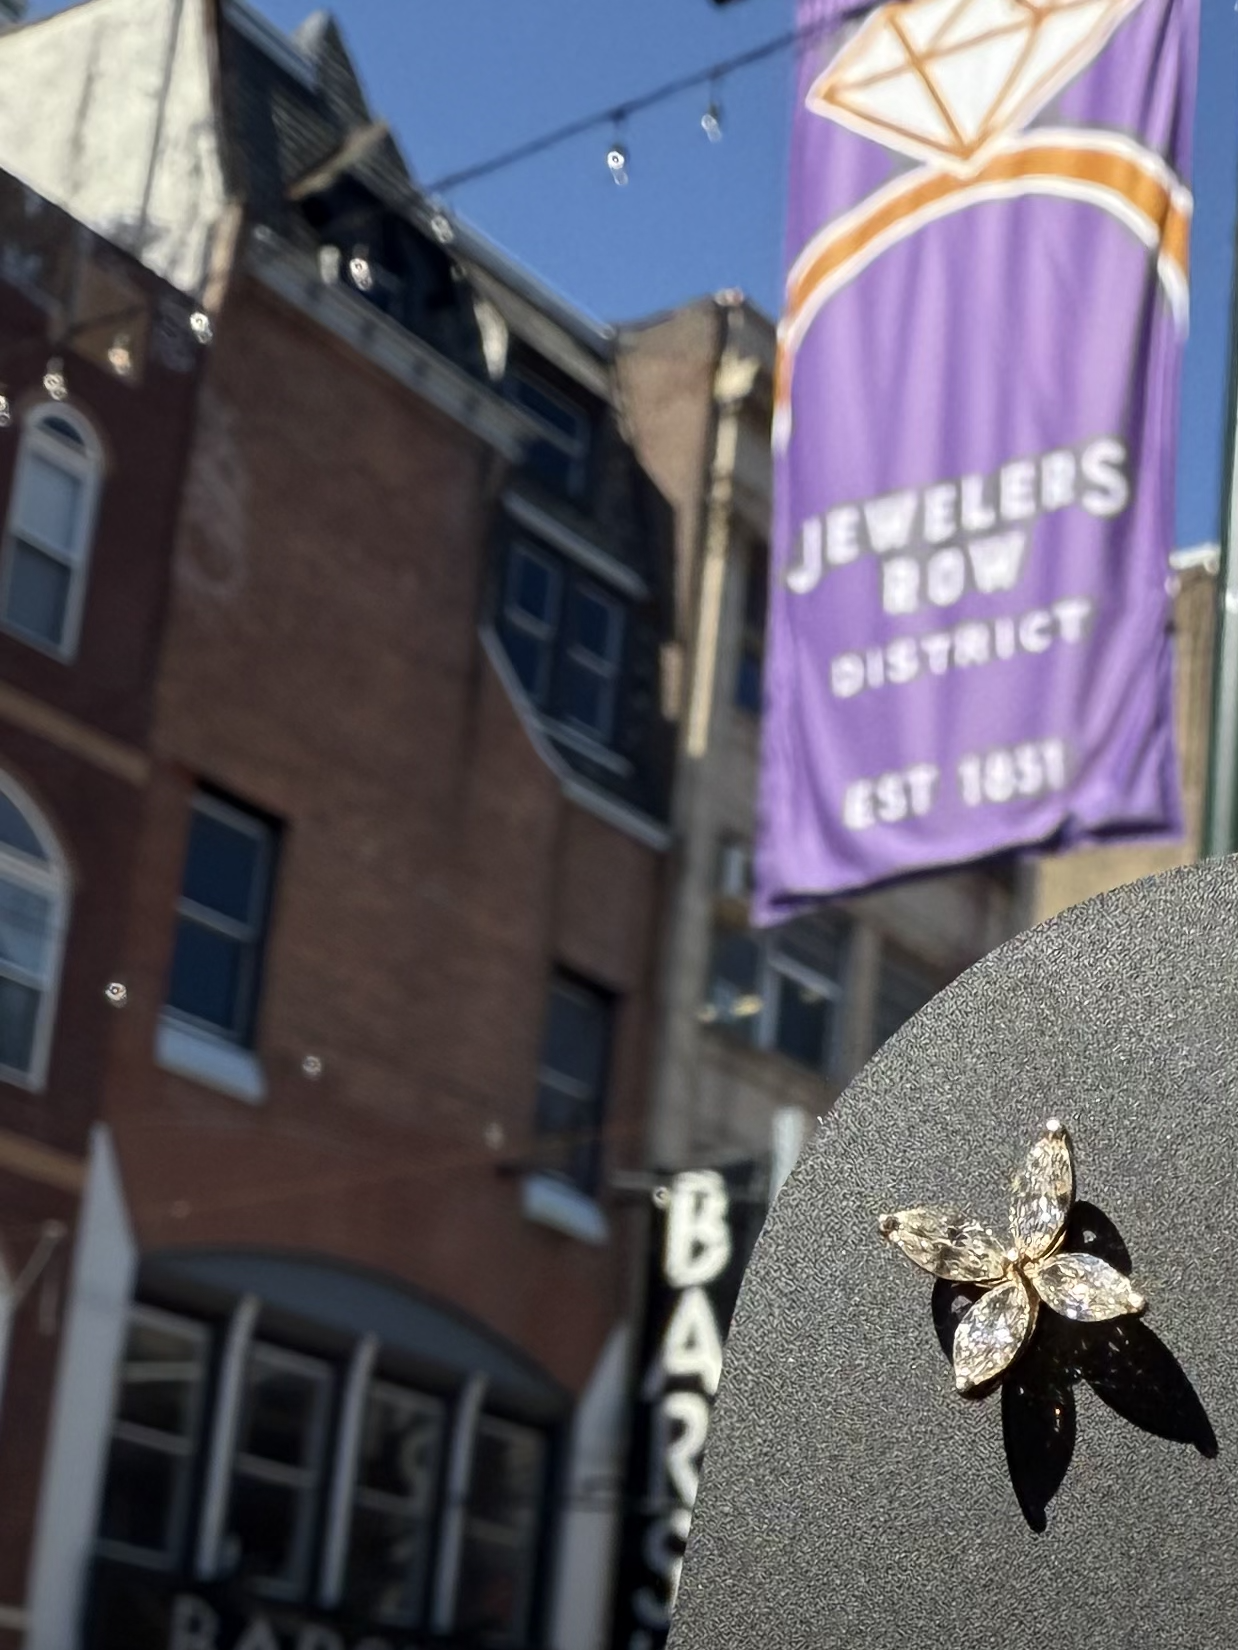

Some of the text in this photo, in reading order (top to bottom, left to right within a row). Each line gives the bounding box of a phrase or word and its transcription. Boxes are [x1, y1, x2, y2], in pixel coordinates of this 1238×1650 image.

[786, 438, 1129, 594] JEWELERS
[882, 530, 1026, 615] ROW
[831, 599, 1091, 698] DISTRICT
[842, 762, 938, 830] EST
